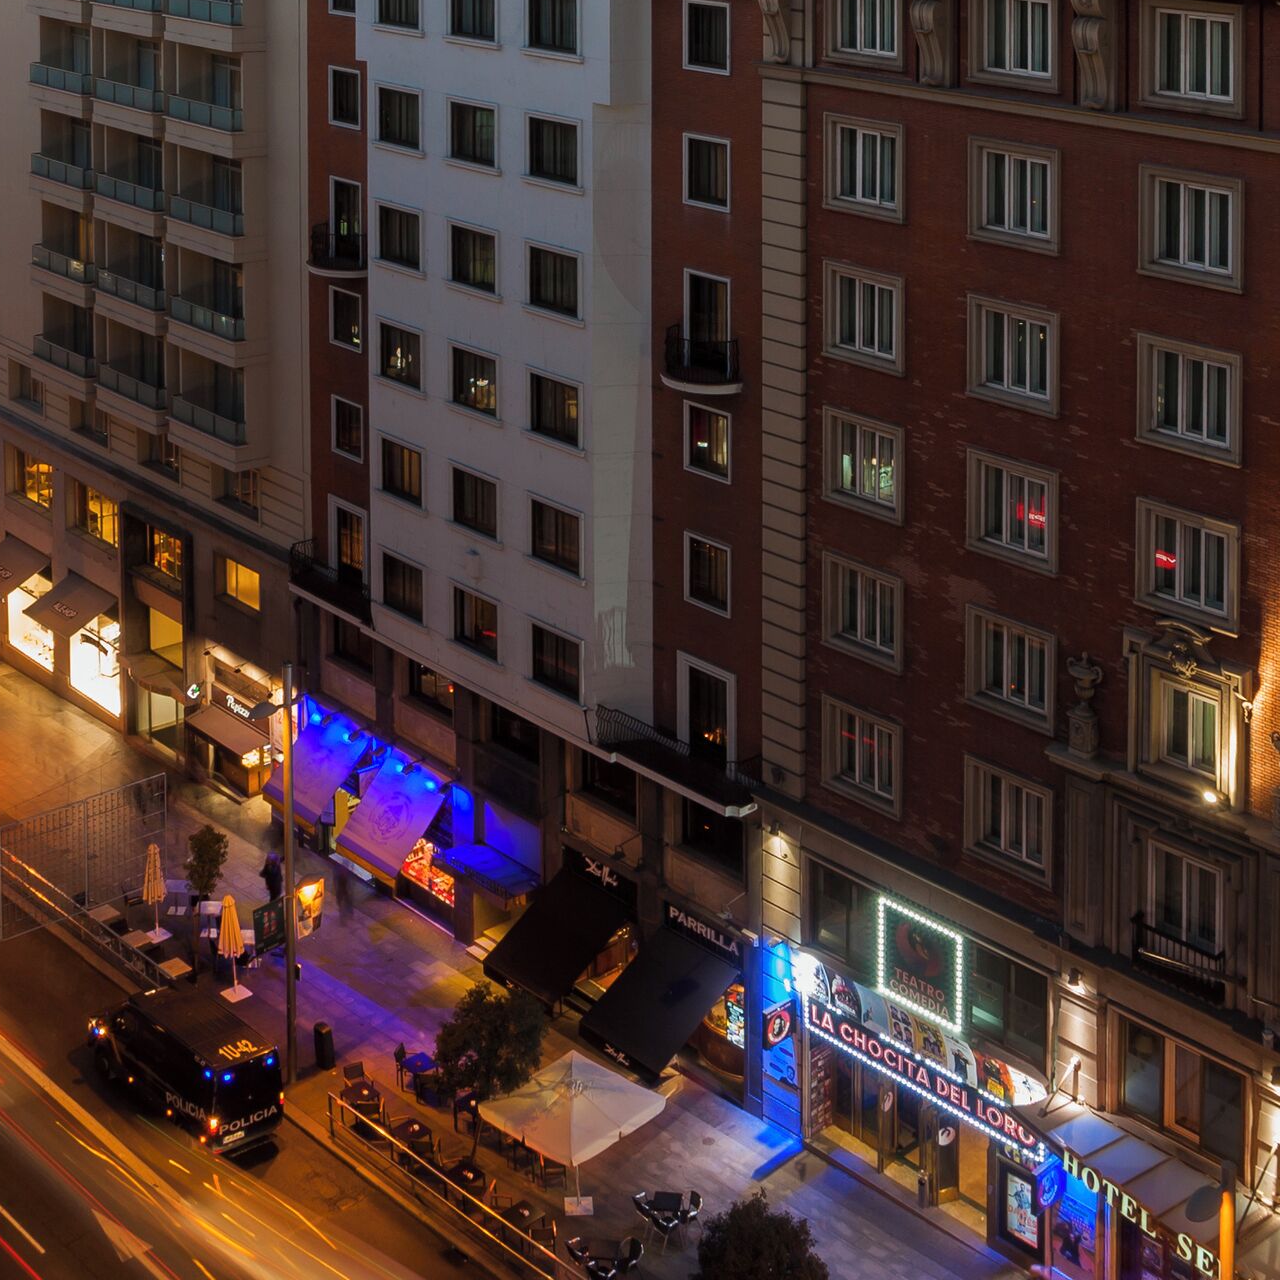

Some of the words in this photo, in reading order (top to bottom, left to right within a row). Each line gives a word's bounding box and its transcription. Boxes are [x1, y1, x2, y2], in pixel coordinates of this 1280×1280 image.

[669, 905, 740, 956] PARRILLA
[889, 978, 951, 1021] COMEDIA
[894, 966, 945, 1002] TEATRO
[810, 1004, 835, 1035] LA
[839, 1021, 932, 1090] CHOCITA
[936, 1074, 971, 1112] DEL
[976, 1097, 1037, 1148] LORO
[166, 1091, 207, 1121] POLICIA
[219, 1105, 278, 1135] POLICIA
[1062, 1149, 1157, 1239] HOTEL
[1176, 1232, 1221, 1280] SE
